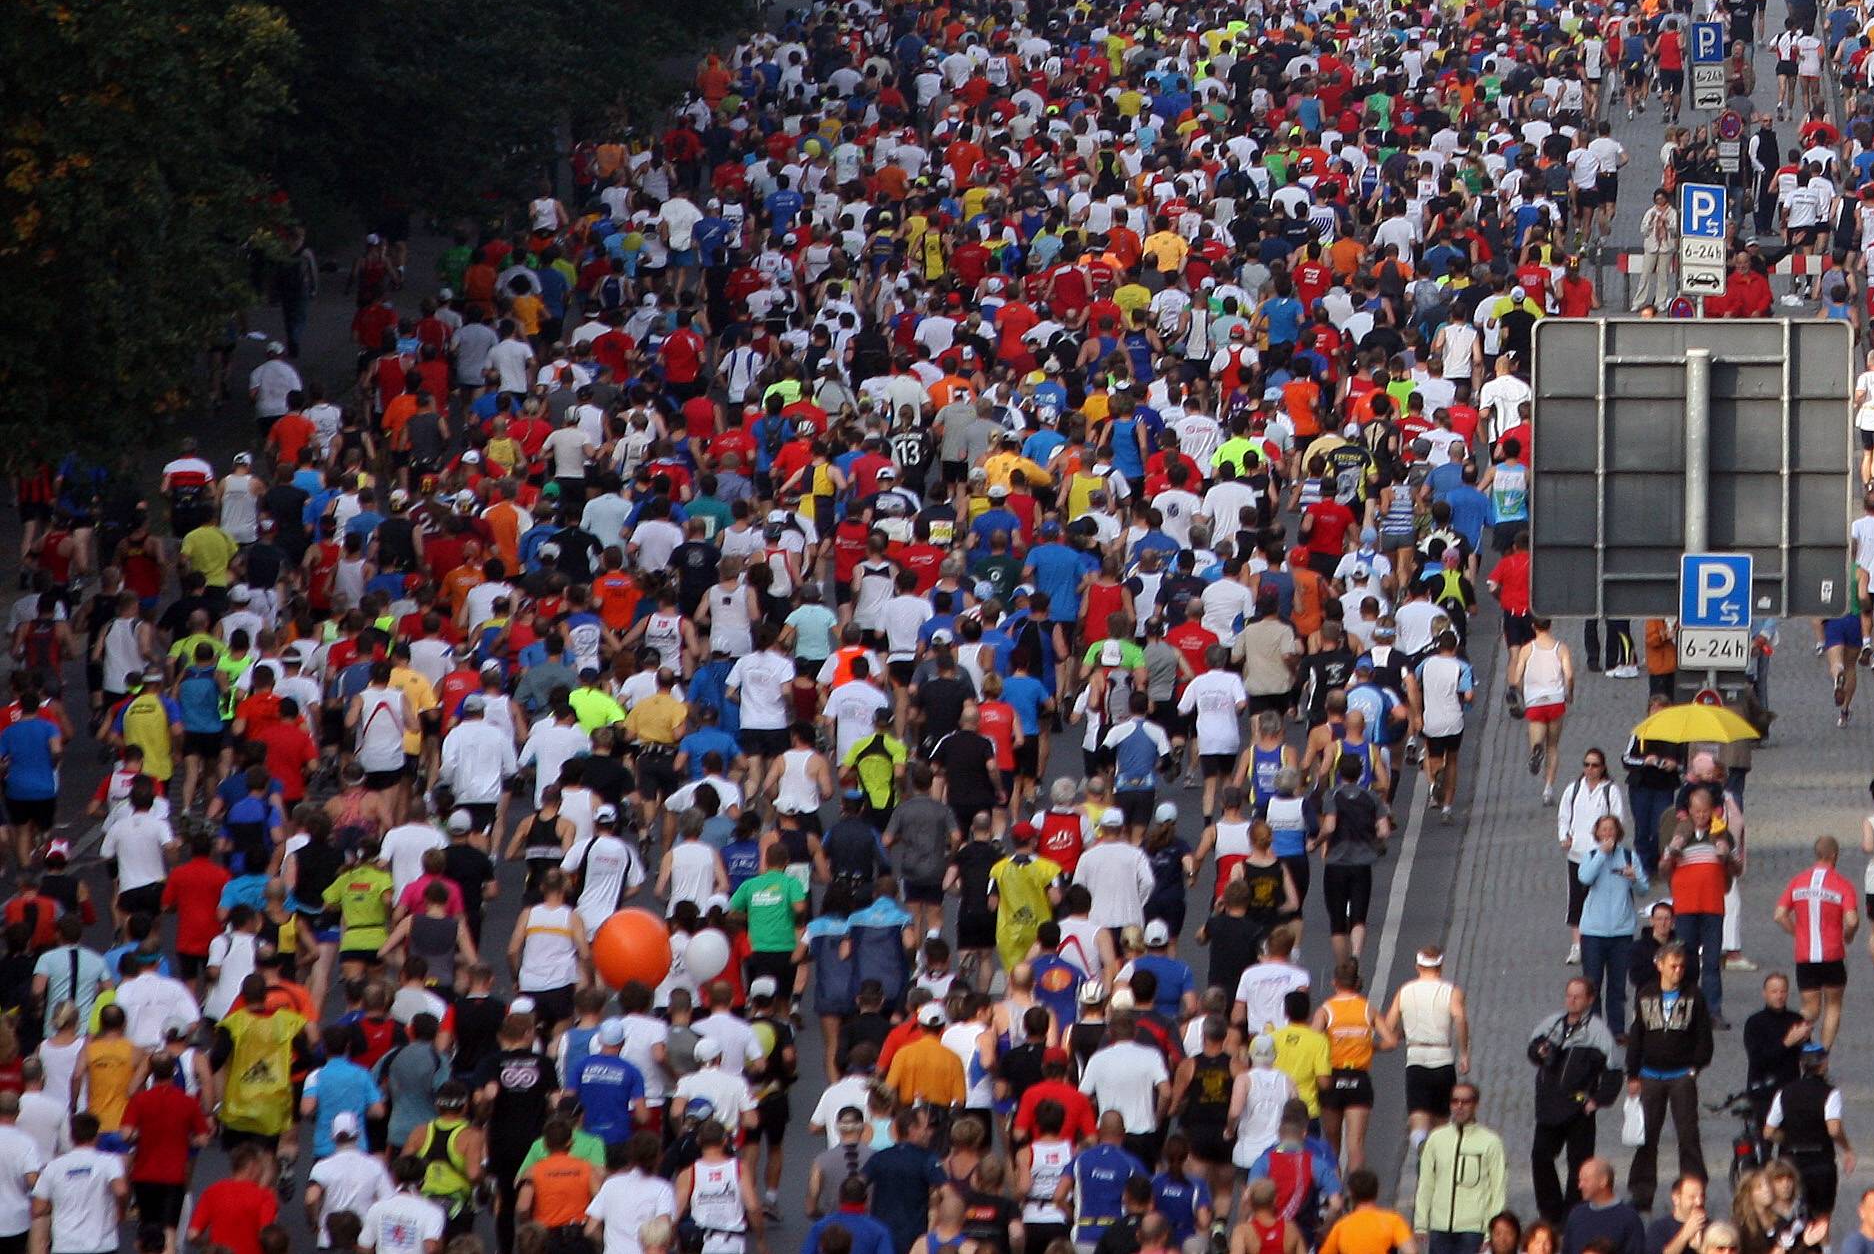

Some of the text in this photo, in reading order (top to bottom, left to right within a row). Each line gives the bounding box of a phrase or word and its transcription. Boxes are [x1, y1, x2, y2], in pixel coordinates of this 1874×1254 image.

[1698, 26, 1716, 59] P
[1691, 190, 1716, 231] P
[896, 440, 920, 466] 13
[1697, 563, 1736, 619] P
